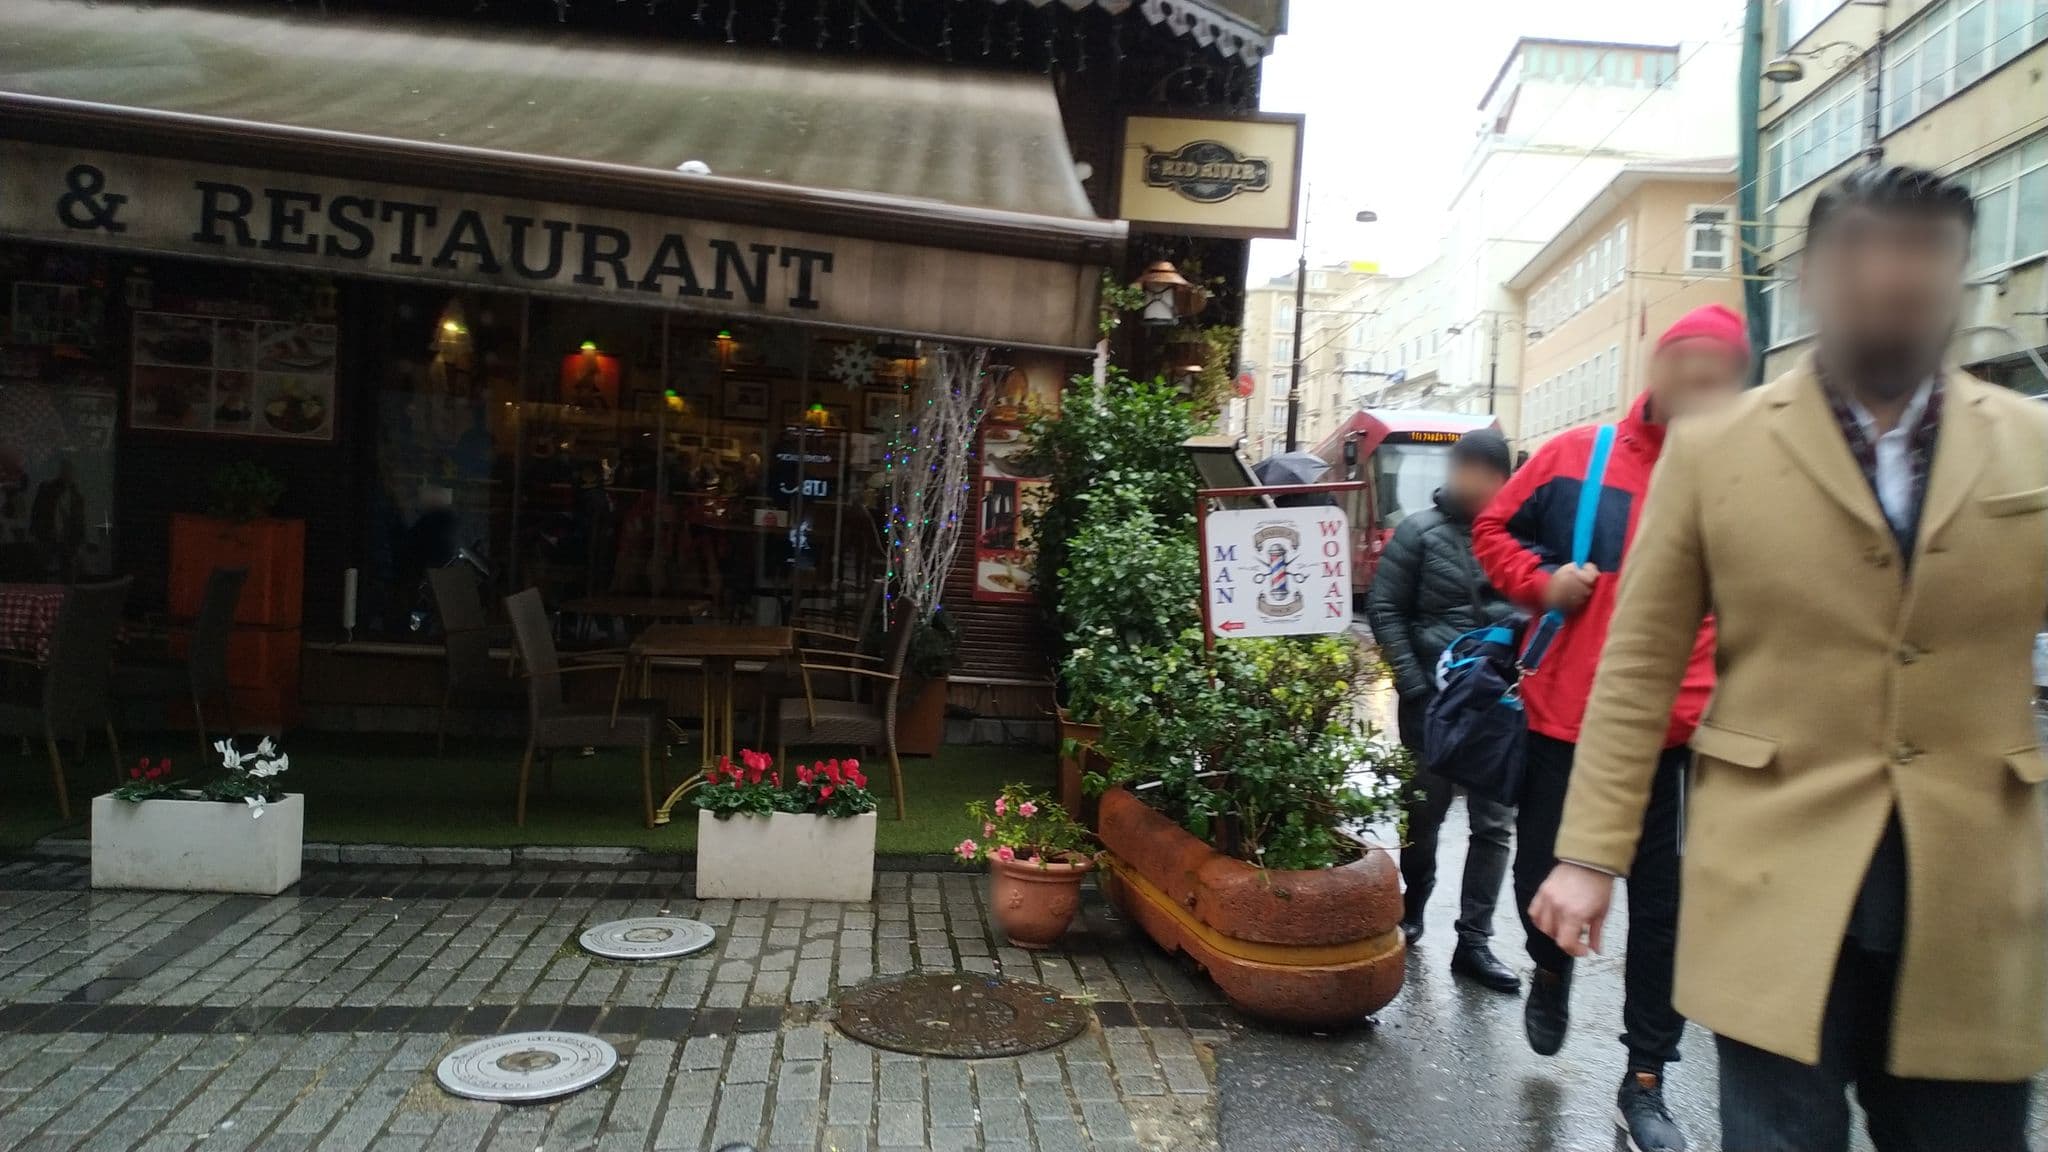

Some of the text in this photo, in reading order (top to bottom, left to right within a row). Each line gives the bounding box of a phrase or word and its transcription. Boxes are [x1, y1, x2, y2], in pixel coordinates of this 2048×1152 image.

[1161, 160, 1256, 181] RED RIVER
[58, 164, 833, 309] & RESTAURANT
[1214, 545, 1237, 604] MAN
[1318, 520, 1345, 618] WOMAN
